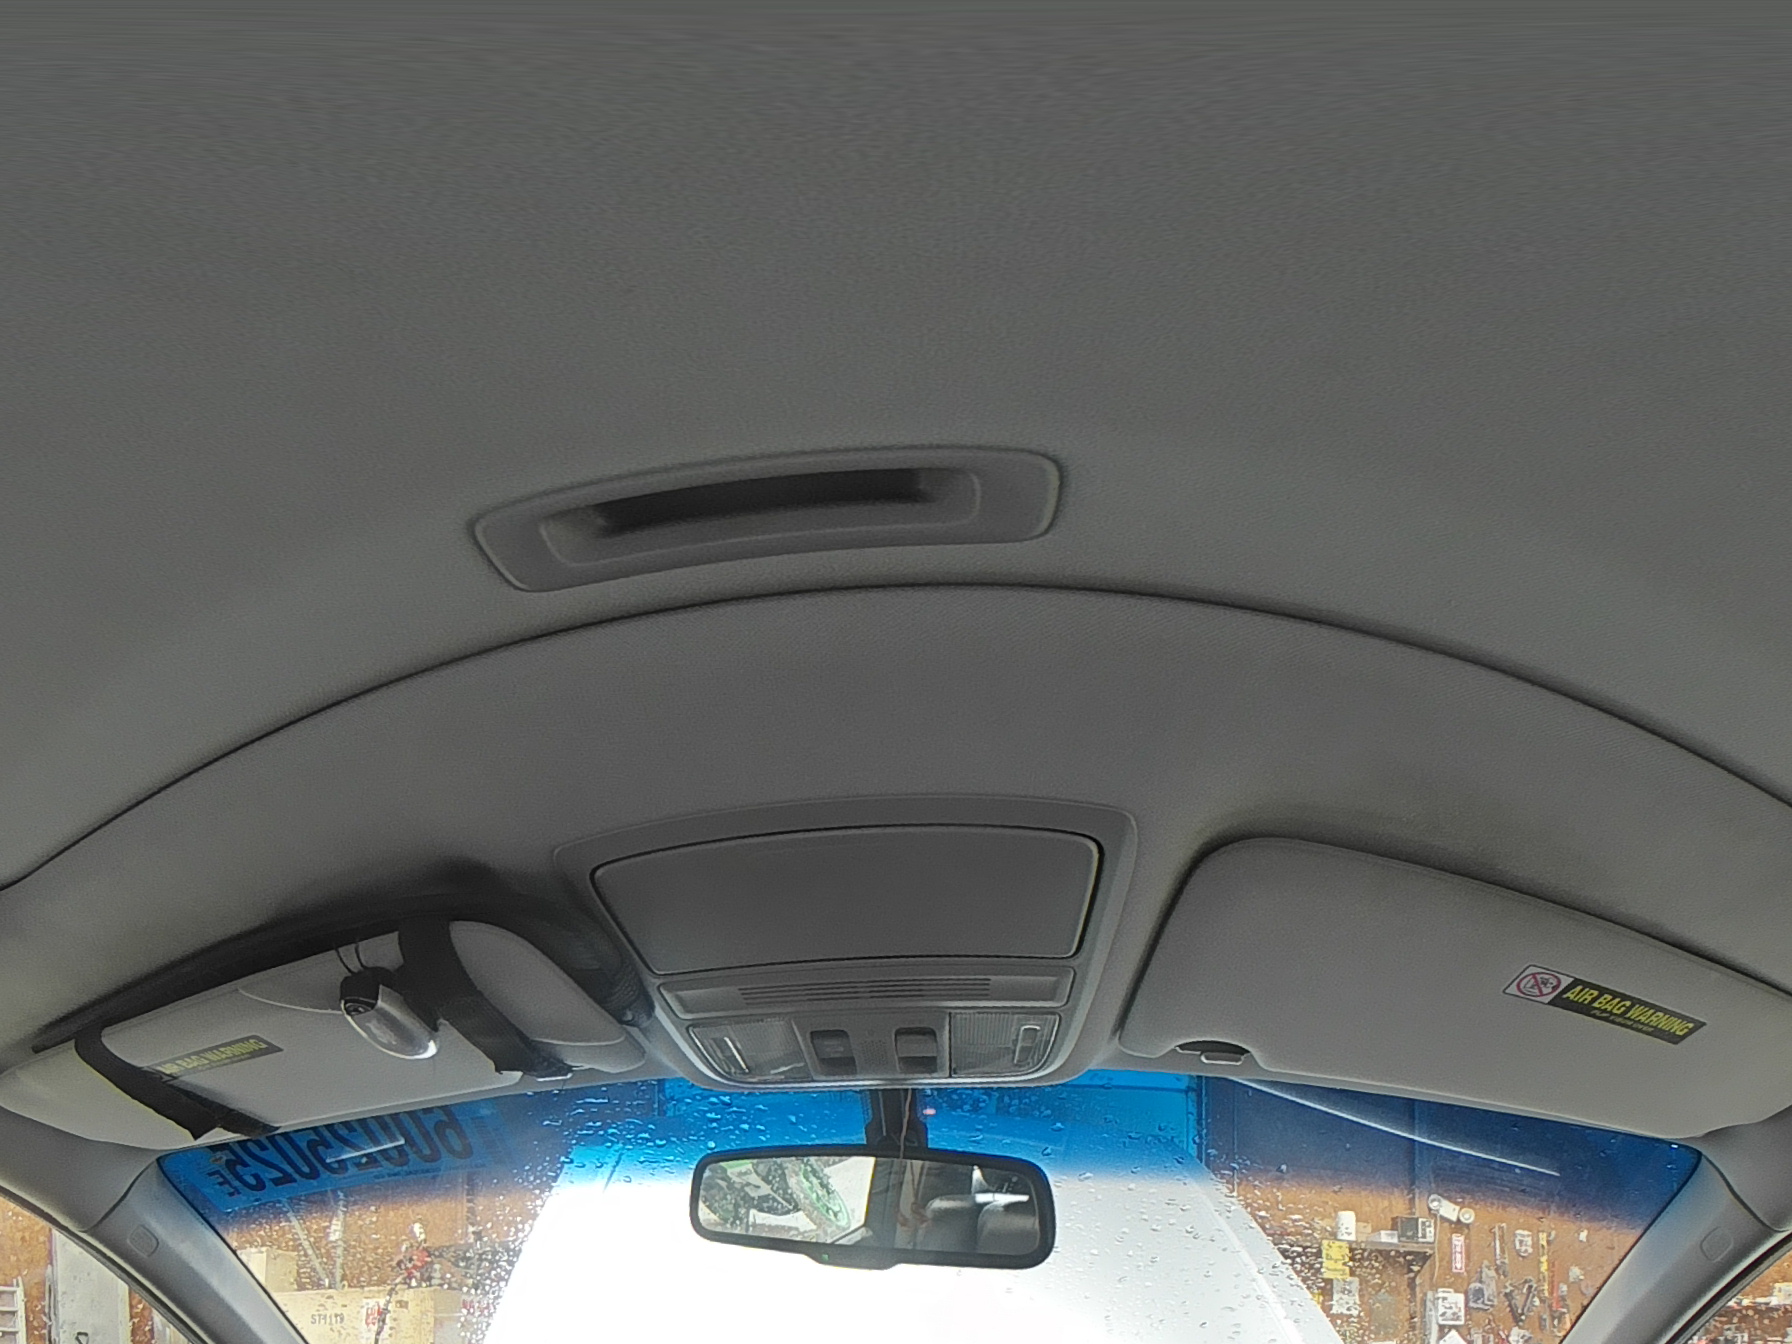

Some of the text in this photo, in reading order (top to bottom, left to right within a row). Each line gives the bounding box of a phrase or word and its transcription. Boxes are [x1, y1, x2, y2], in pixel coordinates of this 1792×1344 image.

[1561, 984, 1695, 1036] AIR BAG WARNING
[202, 1039, 268, 1061] WARNING
